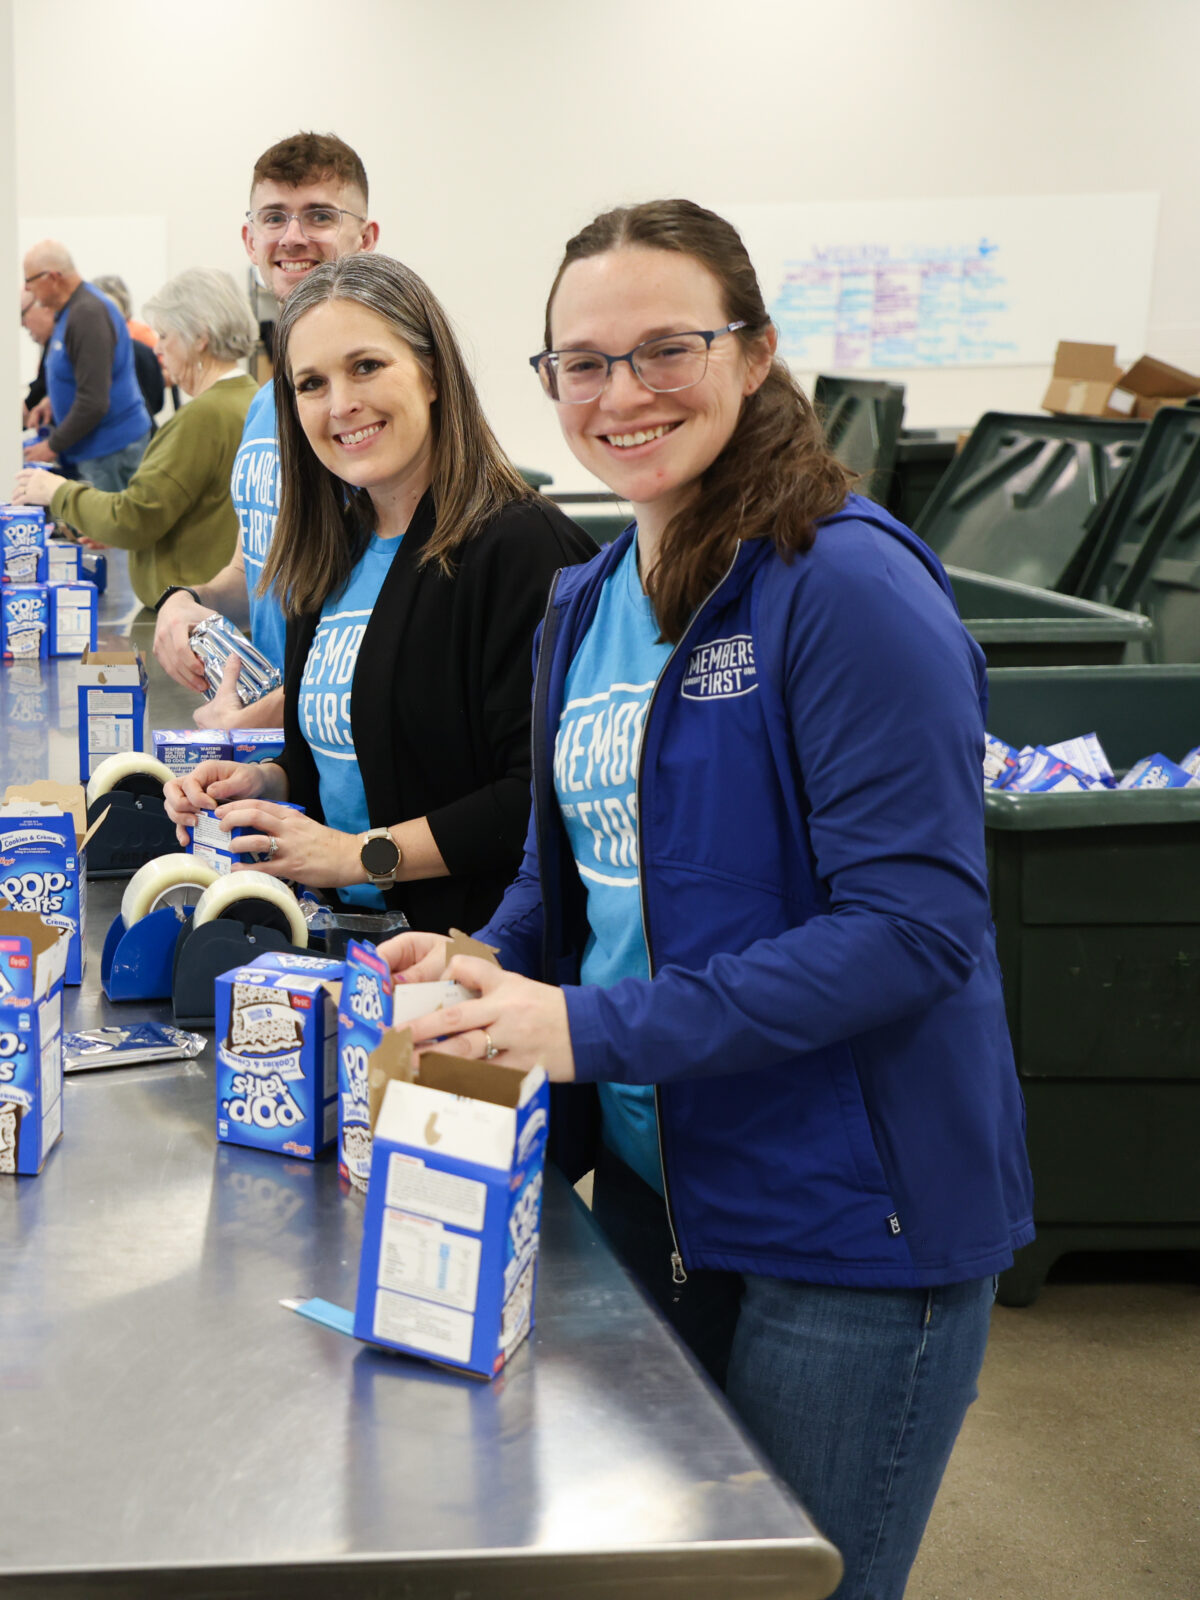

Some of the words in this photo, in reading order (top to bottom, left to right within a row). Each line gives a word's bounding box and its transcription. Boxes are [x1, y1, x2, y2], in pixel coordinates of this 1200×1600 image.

[688, 641, 755, 676] MEMBERS
[700, 668, 743, 695] FIRST
[4, 834, 29, 848] Cookies
[262, 1056, 296, 1067] Cookies
